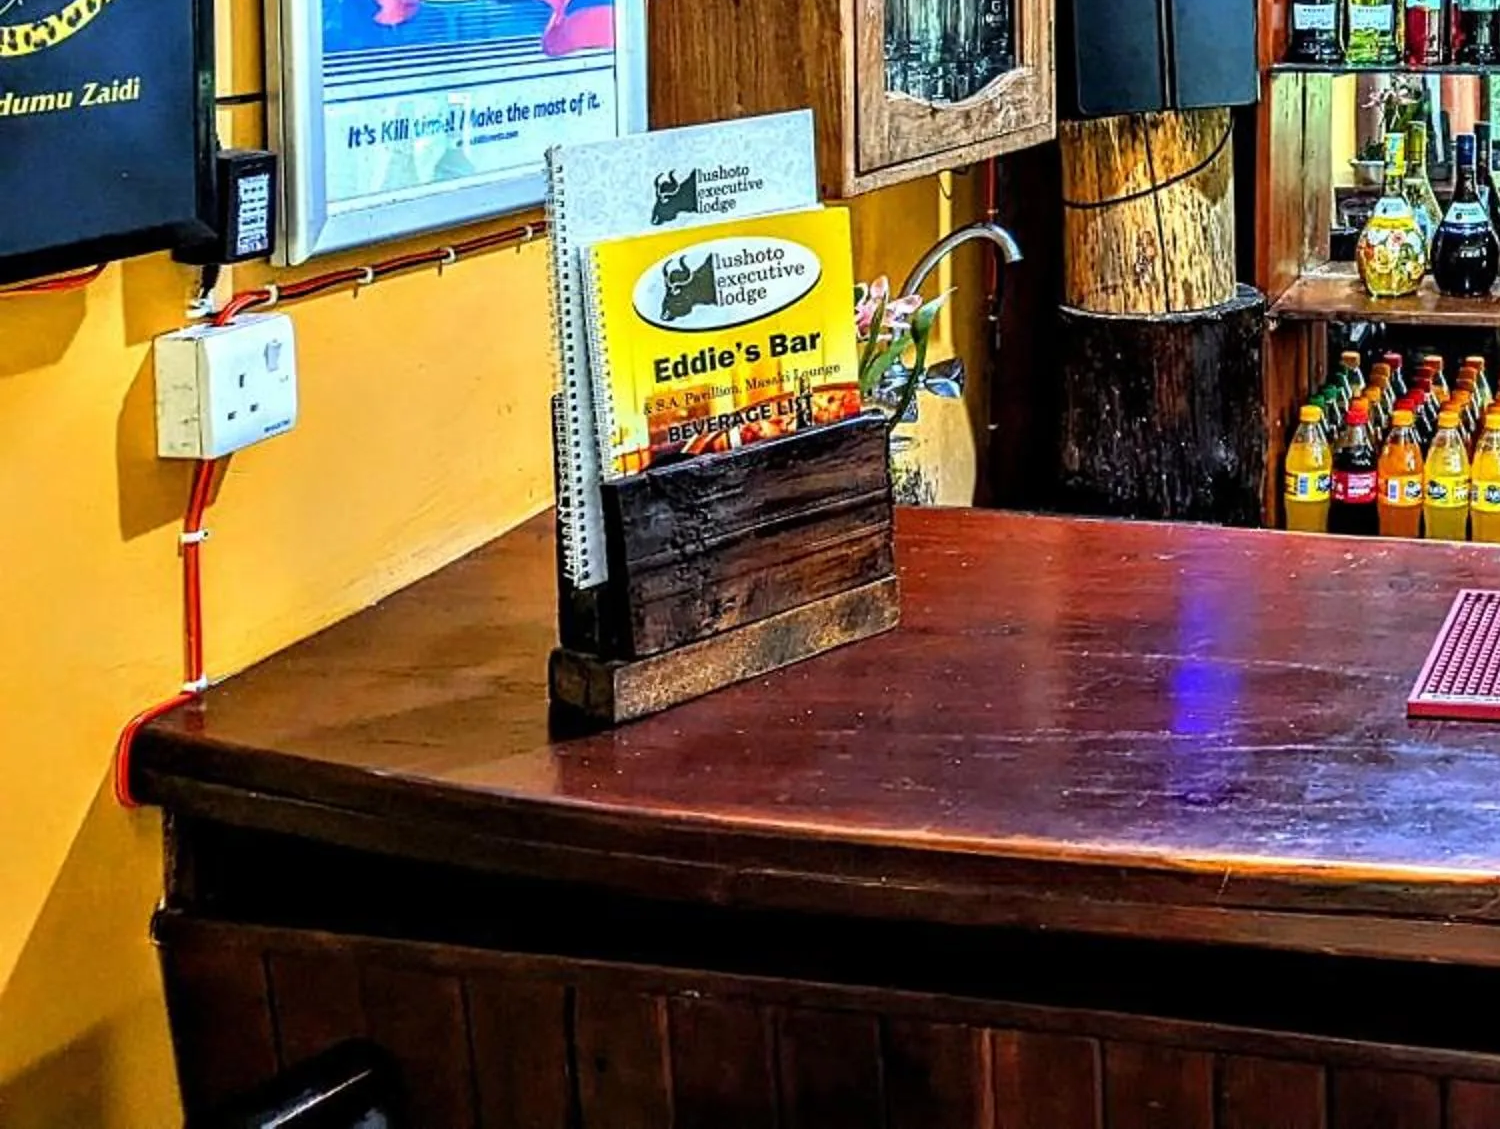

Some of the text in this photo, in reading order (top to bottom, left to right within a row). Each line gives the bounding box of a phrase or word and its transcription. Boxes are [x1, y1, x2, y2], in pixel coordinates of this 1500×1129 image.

[80, 75, 141, 107] Zaidi
[347, 123, 376, 148] It's
[381, 118, 409, 143] Kili
[506, 101, 530, 122] the
[533, 96, 567, 119] most
[569, 92, 585, 117] of
[698, 163, 749, 185] lushoto
[698, 177, 764, 198] executive
[699, 195, 737, 216] lodge
[714, 246, 785, 271] lushoto
[717, 262, 806, 289] executive
[718, 283, 768, 309] lodge
[653, 330, 822, 384] Eddie's Bar
[668, 392, 814, 444] BEVERAGE LIST
